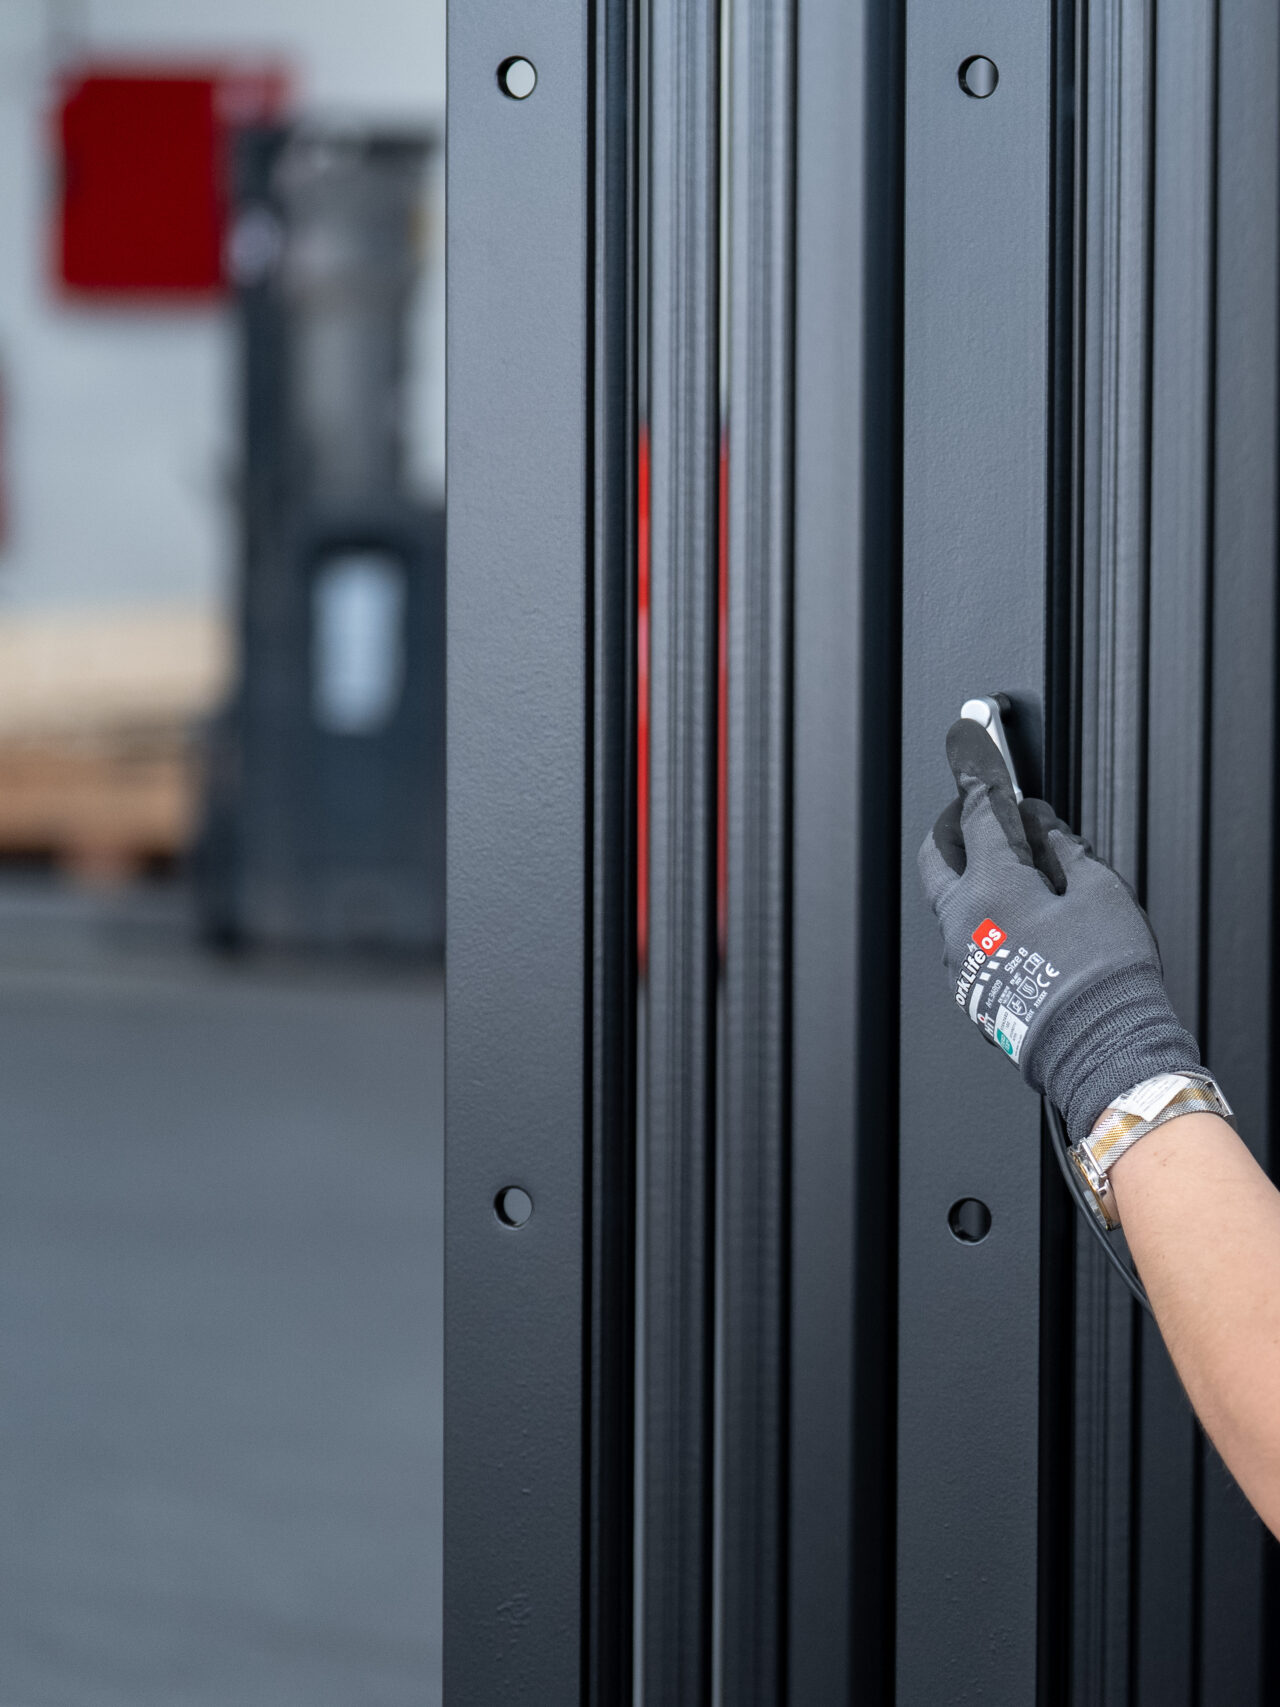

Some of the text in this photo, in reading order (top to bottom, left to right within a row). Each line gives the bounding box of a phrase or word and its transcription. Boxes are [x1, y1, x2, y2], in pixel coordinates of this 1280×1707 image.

[955, 928, 1001, 1010] orkLife os
[1004, 955, 1022, 975] Size
[1018, 947, 1028, 957] 8
